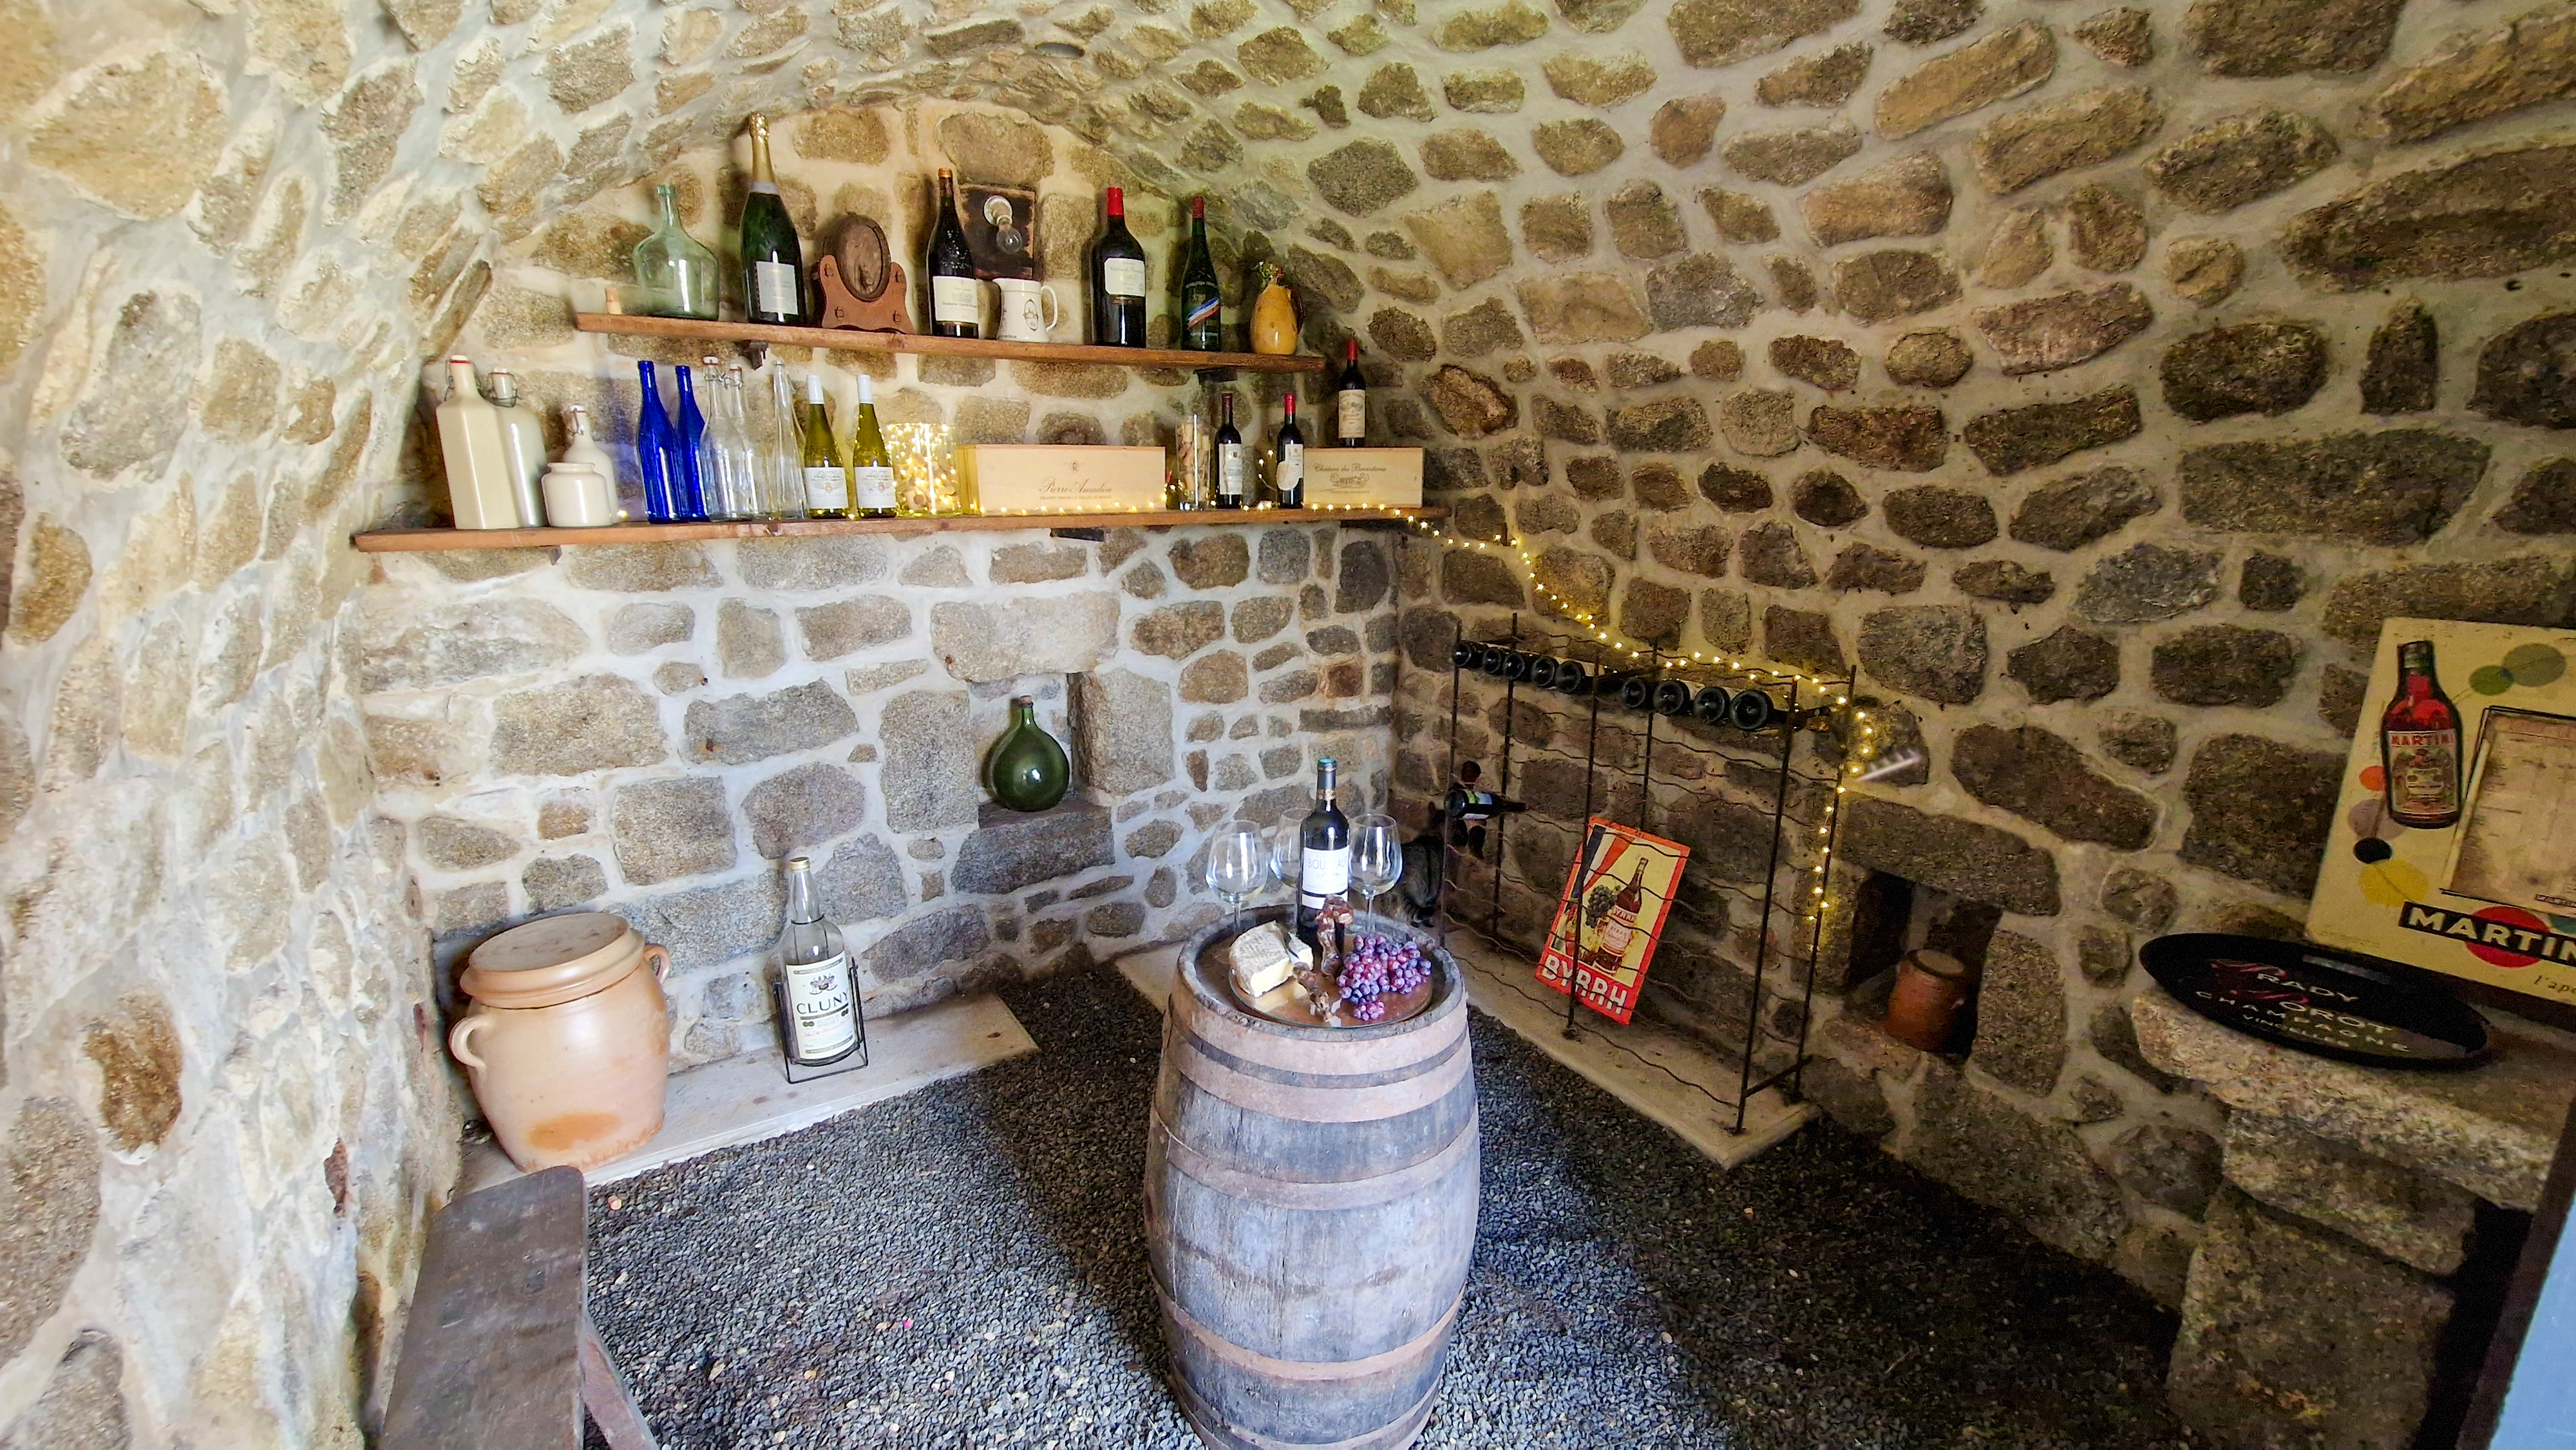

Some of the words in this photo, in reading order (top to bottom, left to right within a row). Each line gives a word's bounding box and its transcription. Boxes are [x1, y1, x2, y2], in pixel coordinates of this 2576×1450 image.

[1039, 476, 1068, 493] Pierre
[1069, 478, 1112, 493] Amadieu
[797, 989, 849, 1014] CLUNY
[1541, 954, 1628, 1015] BYRRH
[2195, 991, 2409, 1052] CHAMPAGNE
